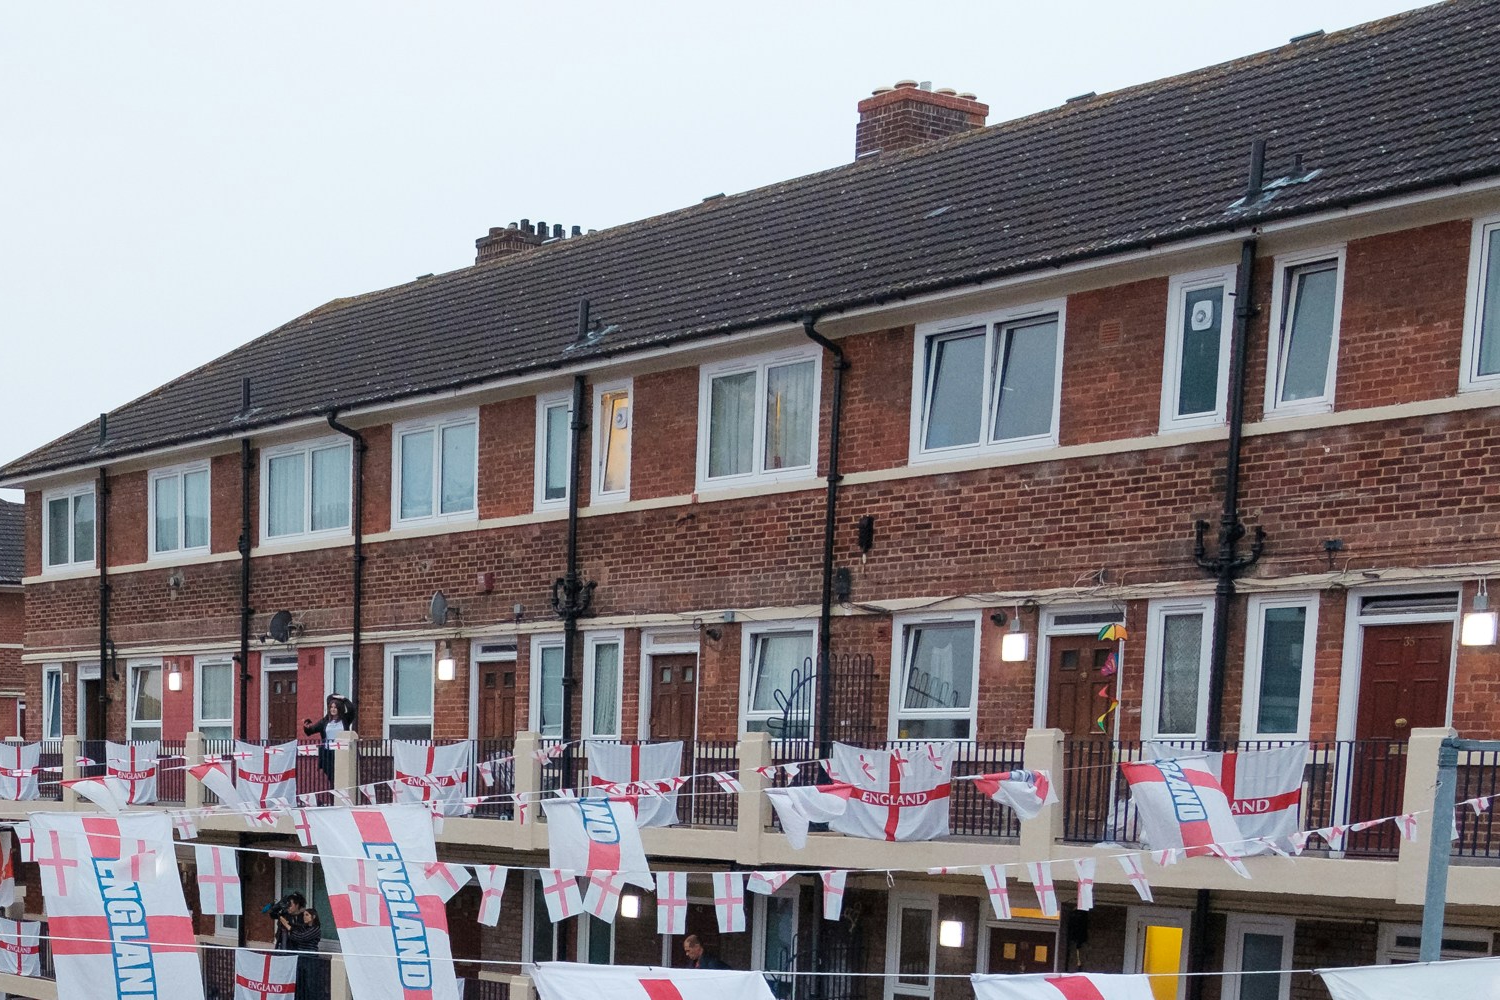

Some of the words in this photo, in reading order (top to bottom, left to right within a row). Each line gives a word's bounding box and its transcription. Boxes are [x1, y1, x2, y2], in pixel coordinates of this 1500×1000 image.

[117, 771, 148, 781] ENGLAND
[249, 773, 283, 784] ENGLAND
[861, 791, 928, 806] ENGLAND
[363, 842, 433, 991] ENGLAND
[248, 980, 283, 993] ENGLAND
